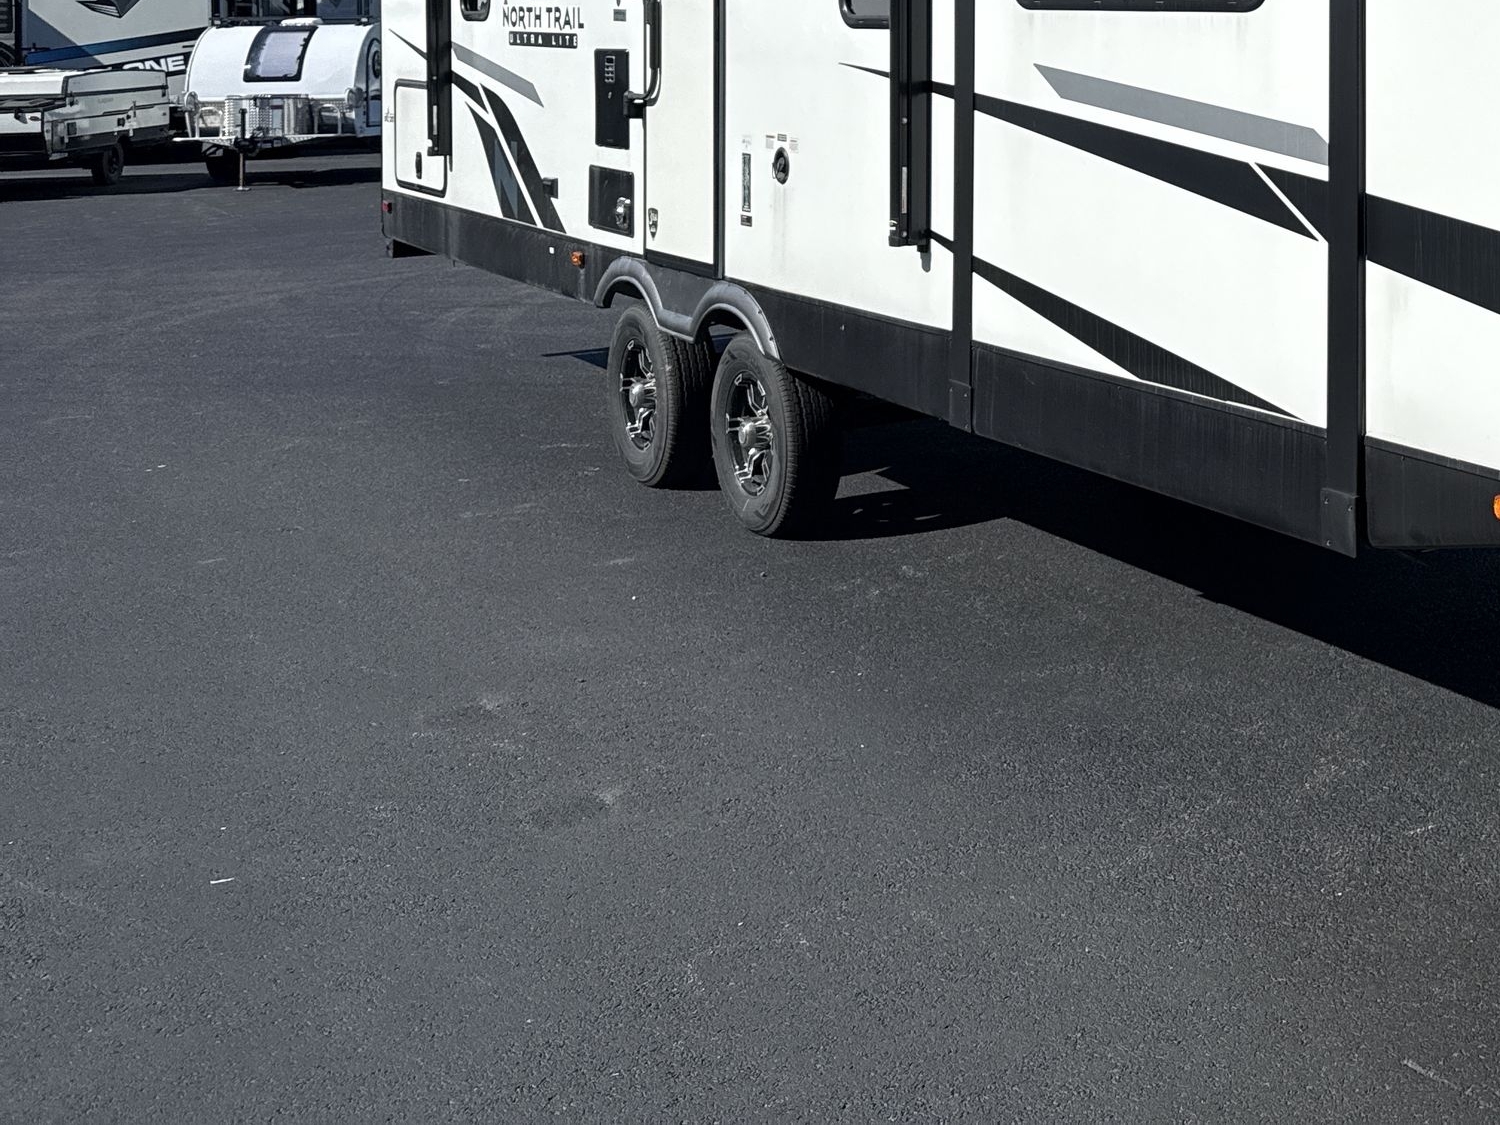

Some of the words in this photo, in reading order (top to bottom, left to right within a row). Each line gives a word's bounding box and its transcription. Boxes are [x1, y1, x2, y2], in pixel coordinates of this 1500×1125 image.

[502, 6, 542, 29] NORTH
[545, 6, 584, 31] TRAIL
[509, 33, 543, 45] ULTRA
[551, 35, 578, 47] LITE
